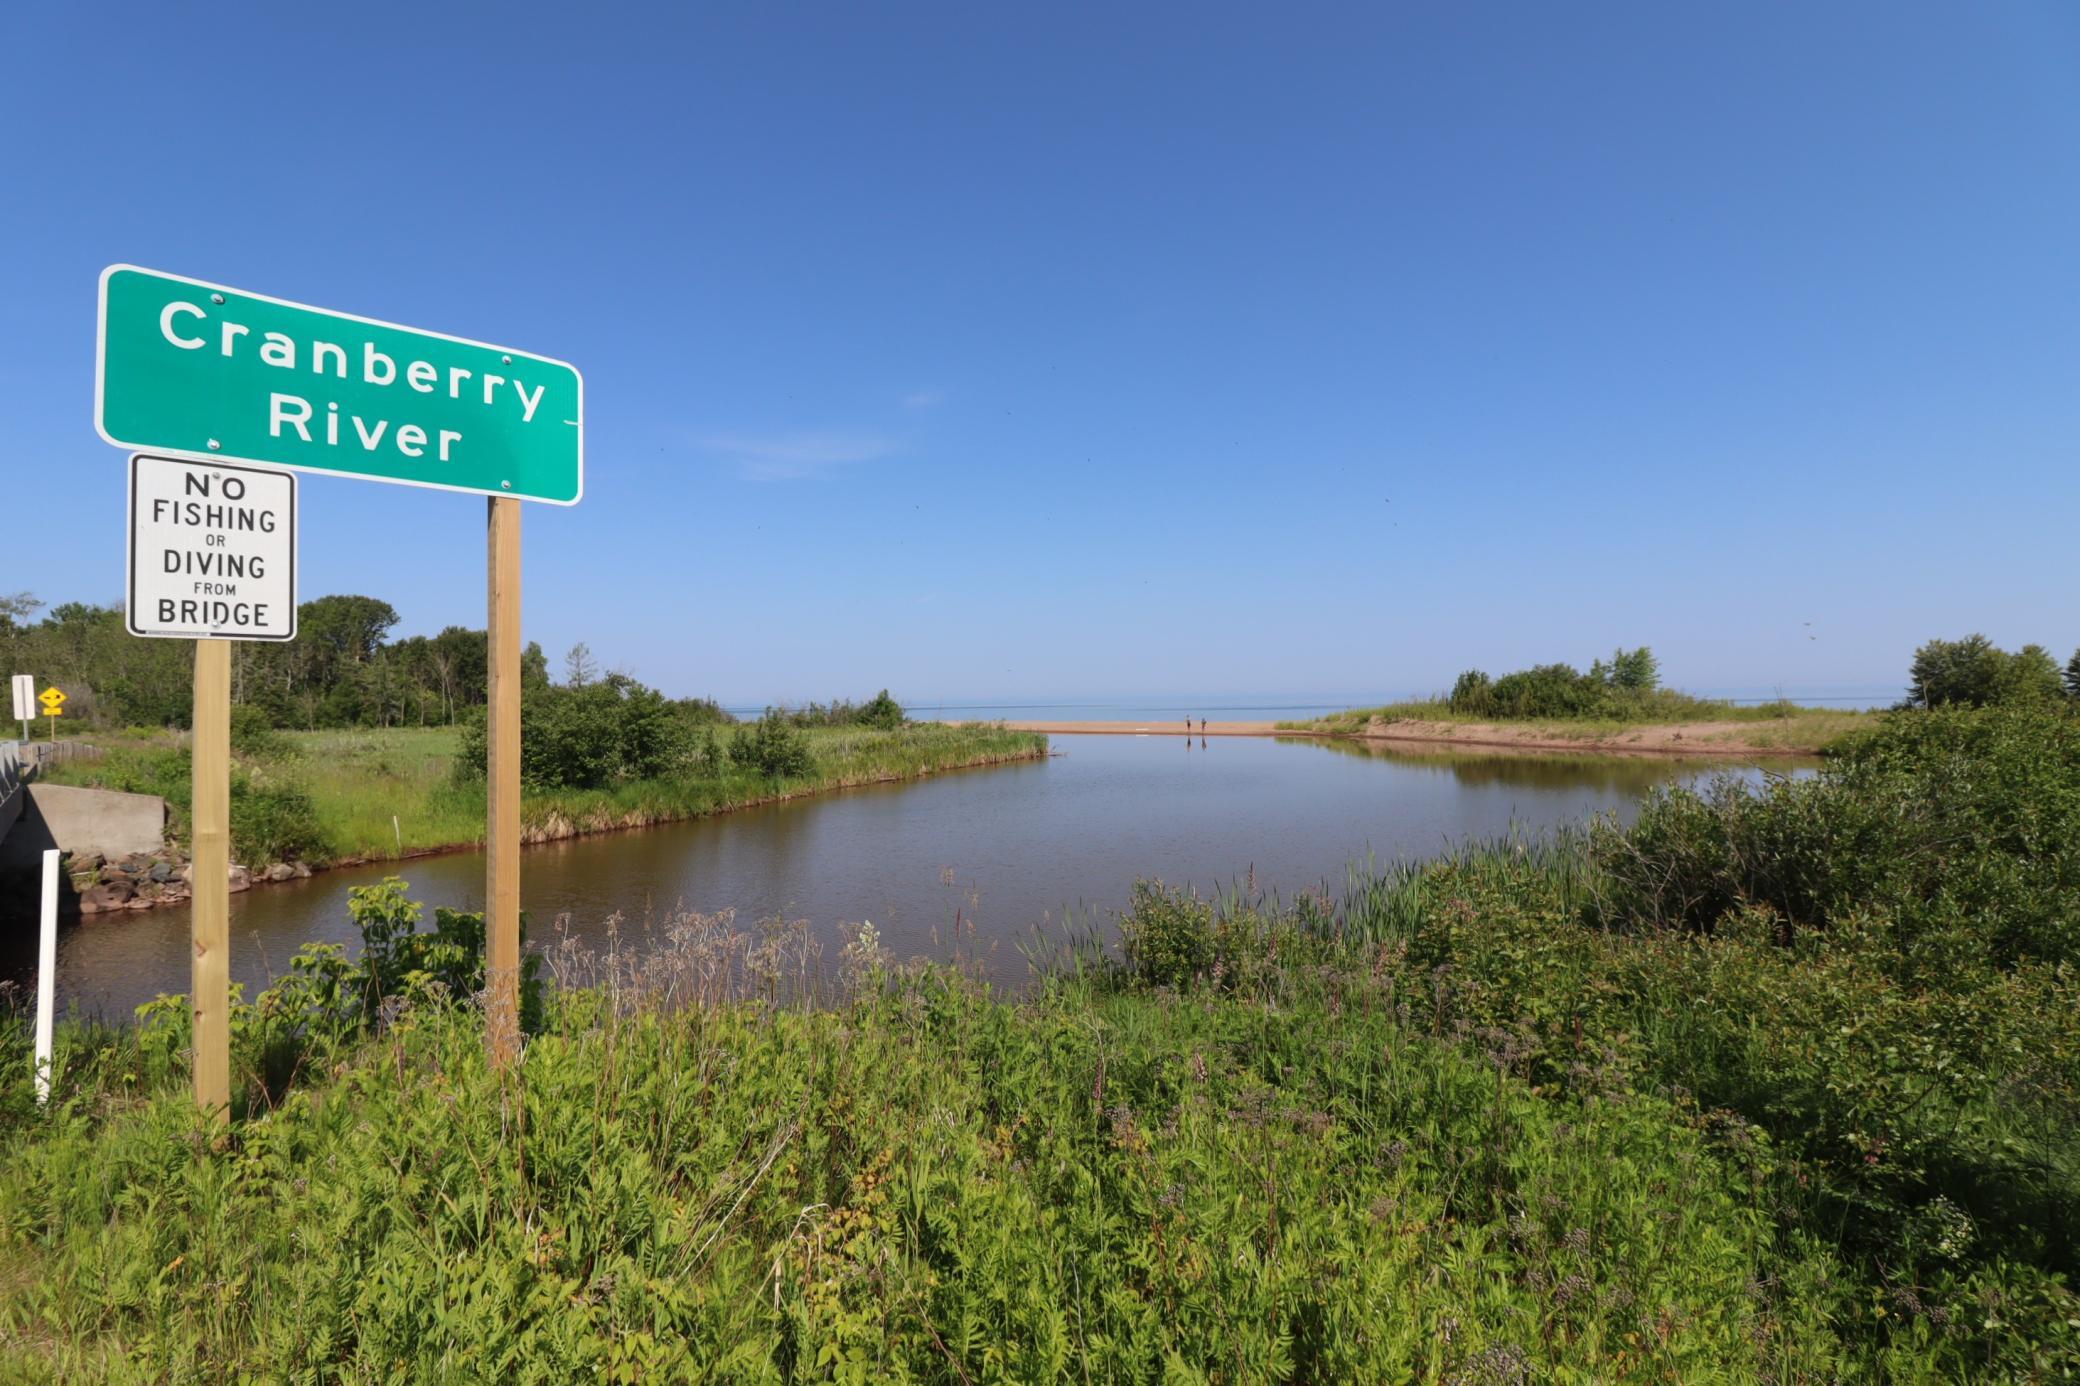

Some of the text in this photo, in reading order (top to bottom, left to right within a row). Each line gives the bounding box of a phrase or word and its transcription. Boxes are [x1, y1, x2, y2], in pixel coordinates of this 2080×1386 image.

[159, 301, 545, 423] Cranberry
[269, 392, 463, 462] River
[185, 472, 245, 501] NO
[153, 498, 275, 533] FISHING
[206, 534, 225, 547] OR
[164, 549, 265, 579] DIVING
[194, 582, 236, 596] FROM
[158, 598, 269, 627] BRIDGE
